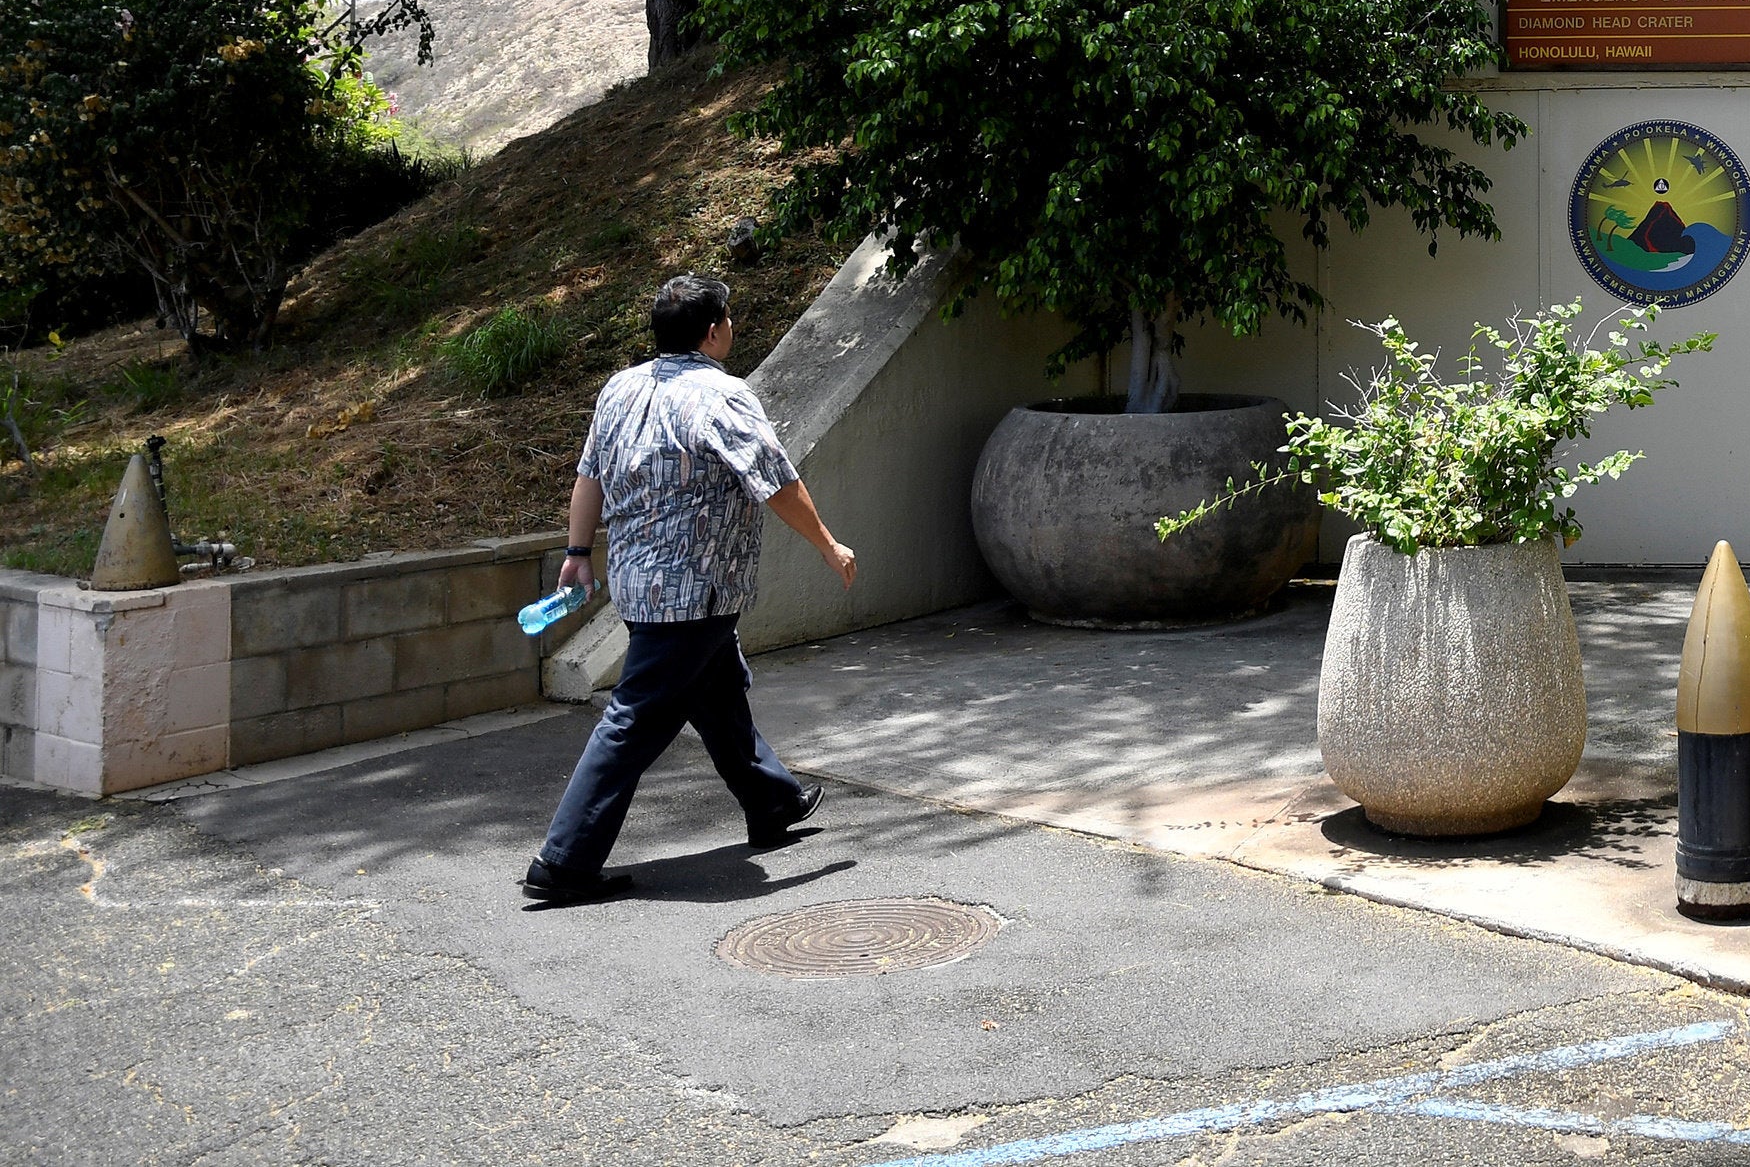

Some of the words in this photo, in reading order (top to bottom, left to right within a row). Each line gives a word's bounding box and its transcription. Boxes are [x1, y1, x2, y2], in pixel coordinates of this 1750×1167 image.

[1519, 17, 1584, 29] DIAMOND
[1593, 17, 1631, 28] HEAD
[1638, 16, 1693, 28] CRATER
[1519, 46, 1599, 60] HONOLULU,
[1606, 46, 1652, 58] HAWAII
[1577, 150, 1609, 196] MALAMA
[1577, 229, 1600, 273] HAWAII
[1603, 275, 1679, 302] EMERGENCY
[1686, 229, 1747, 298] MANAGEMENT
